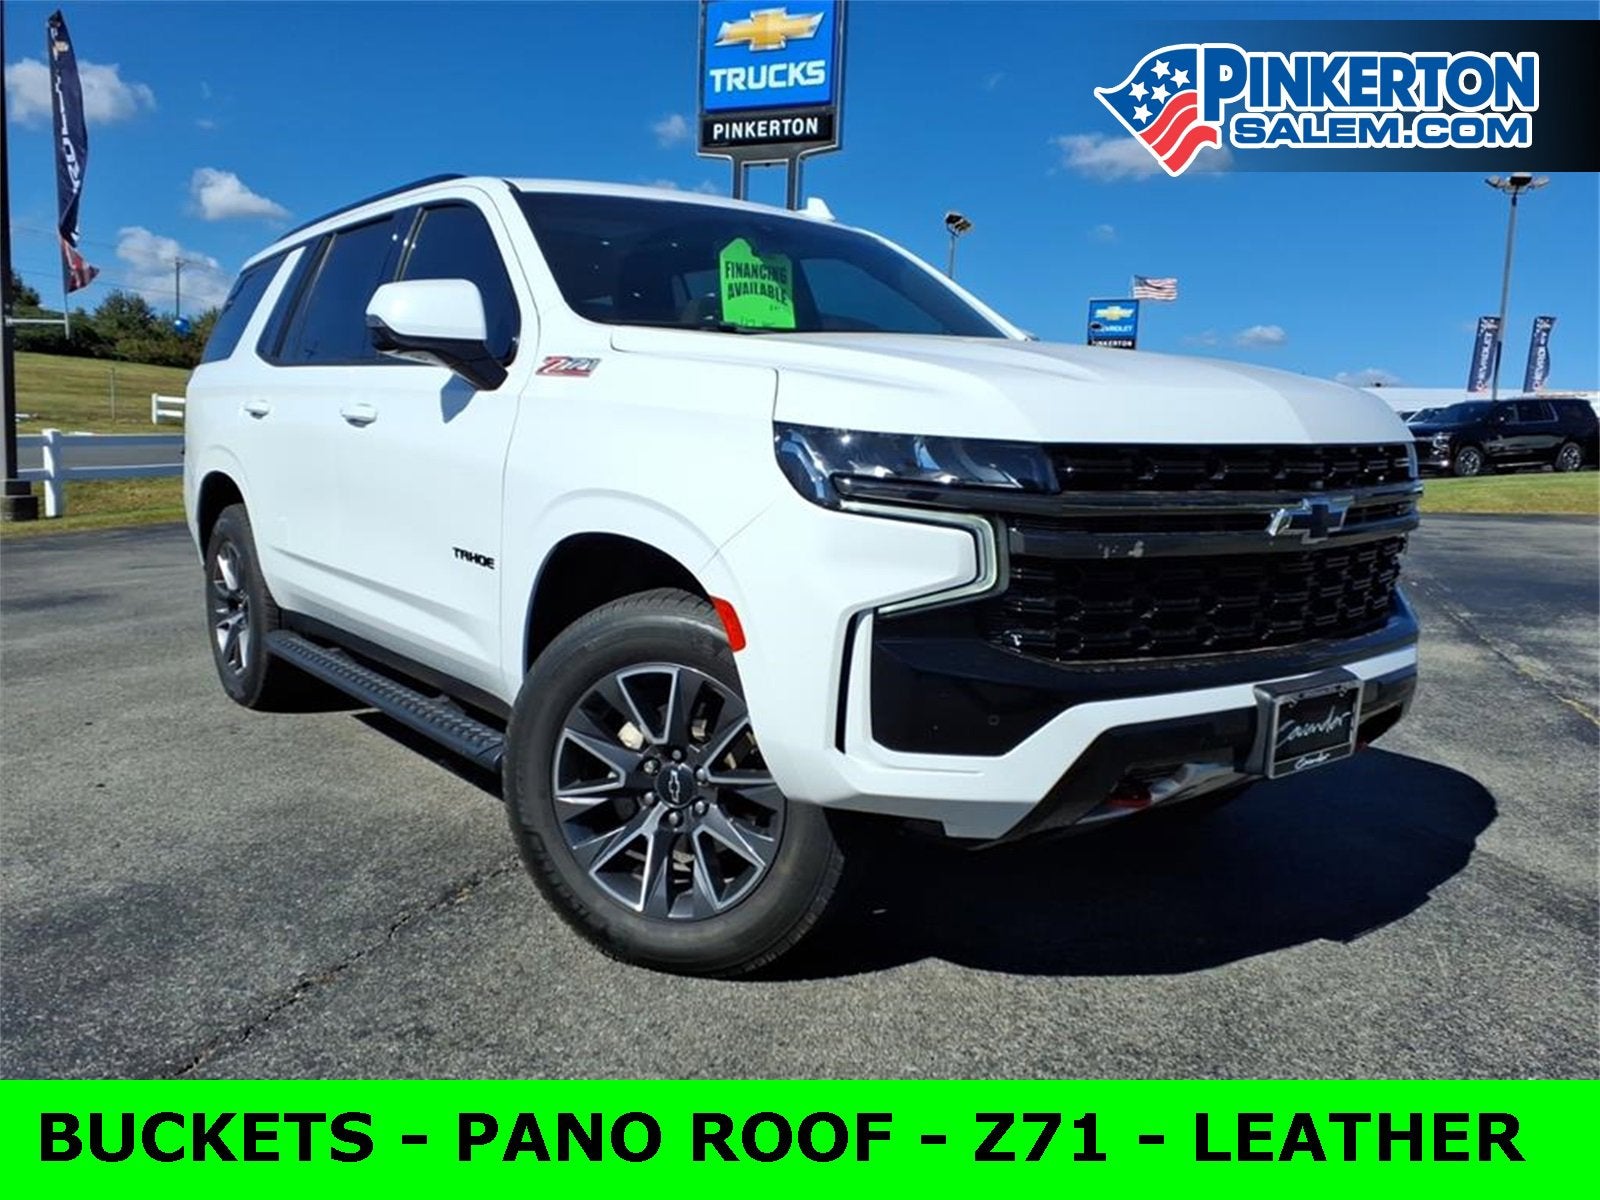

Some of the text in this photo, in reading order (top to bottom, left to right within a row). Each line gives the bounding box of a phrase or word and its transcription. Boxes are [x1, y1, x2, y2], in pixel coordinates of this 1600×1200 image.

[709, 60, 826, 93] TRUCKS
[713, 117, 819, 141] PINKERTON
[725, 261, 788, 284] FINANCING
[727, 281, 788, 306] AVAILABLE
[535, 356, 601, 378] Z71
[452, 546, 495, 570] TAHOE
